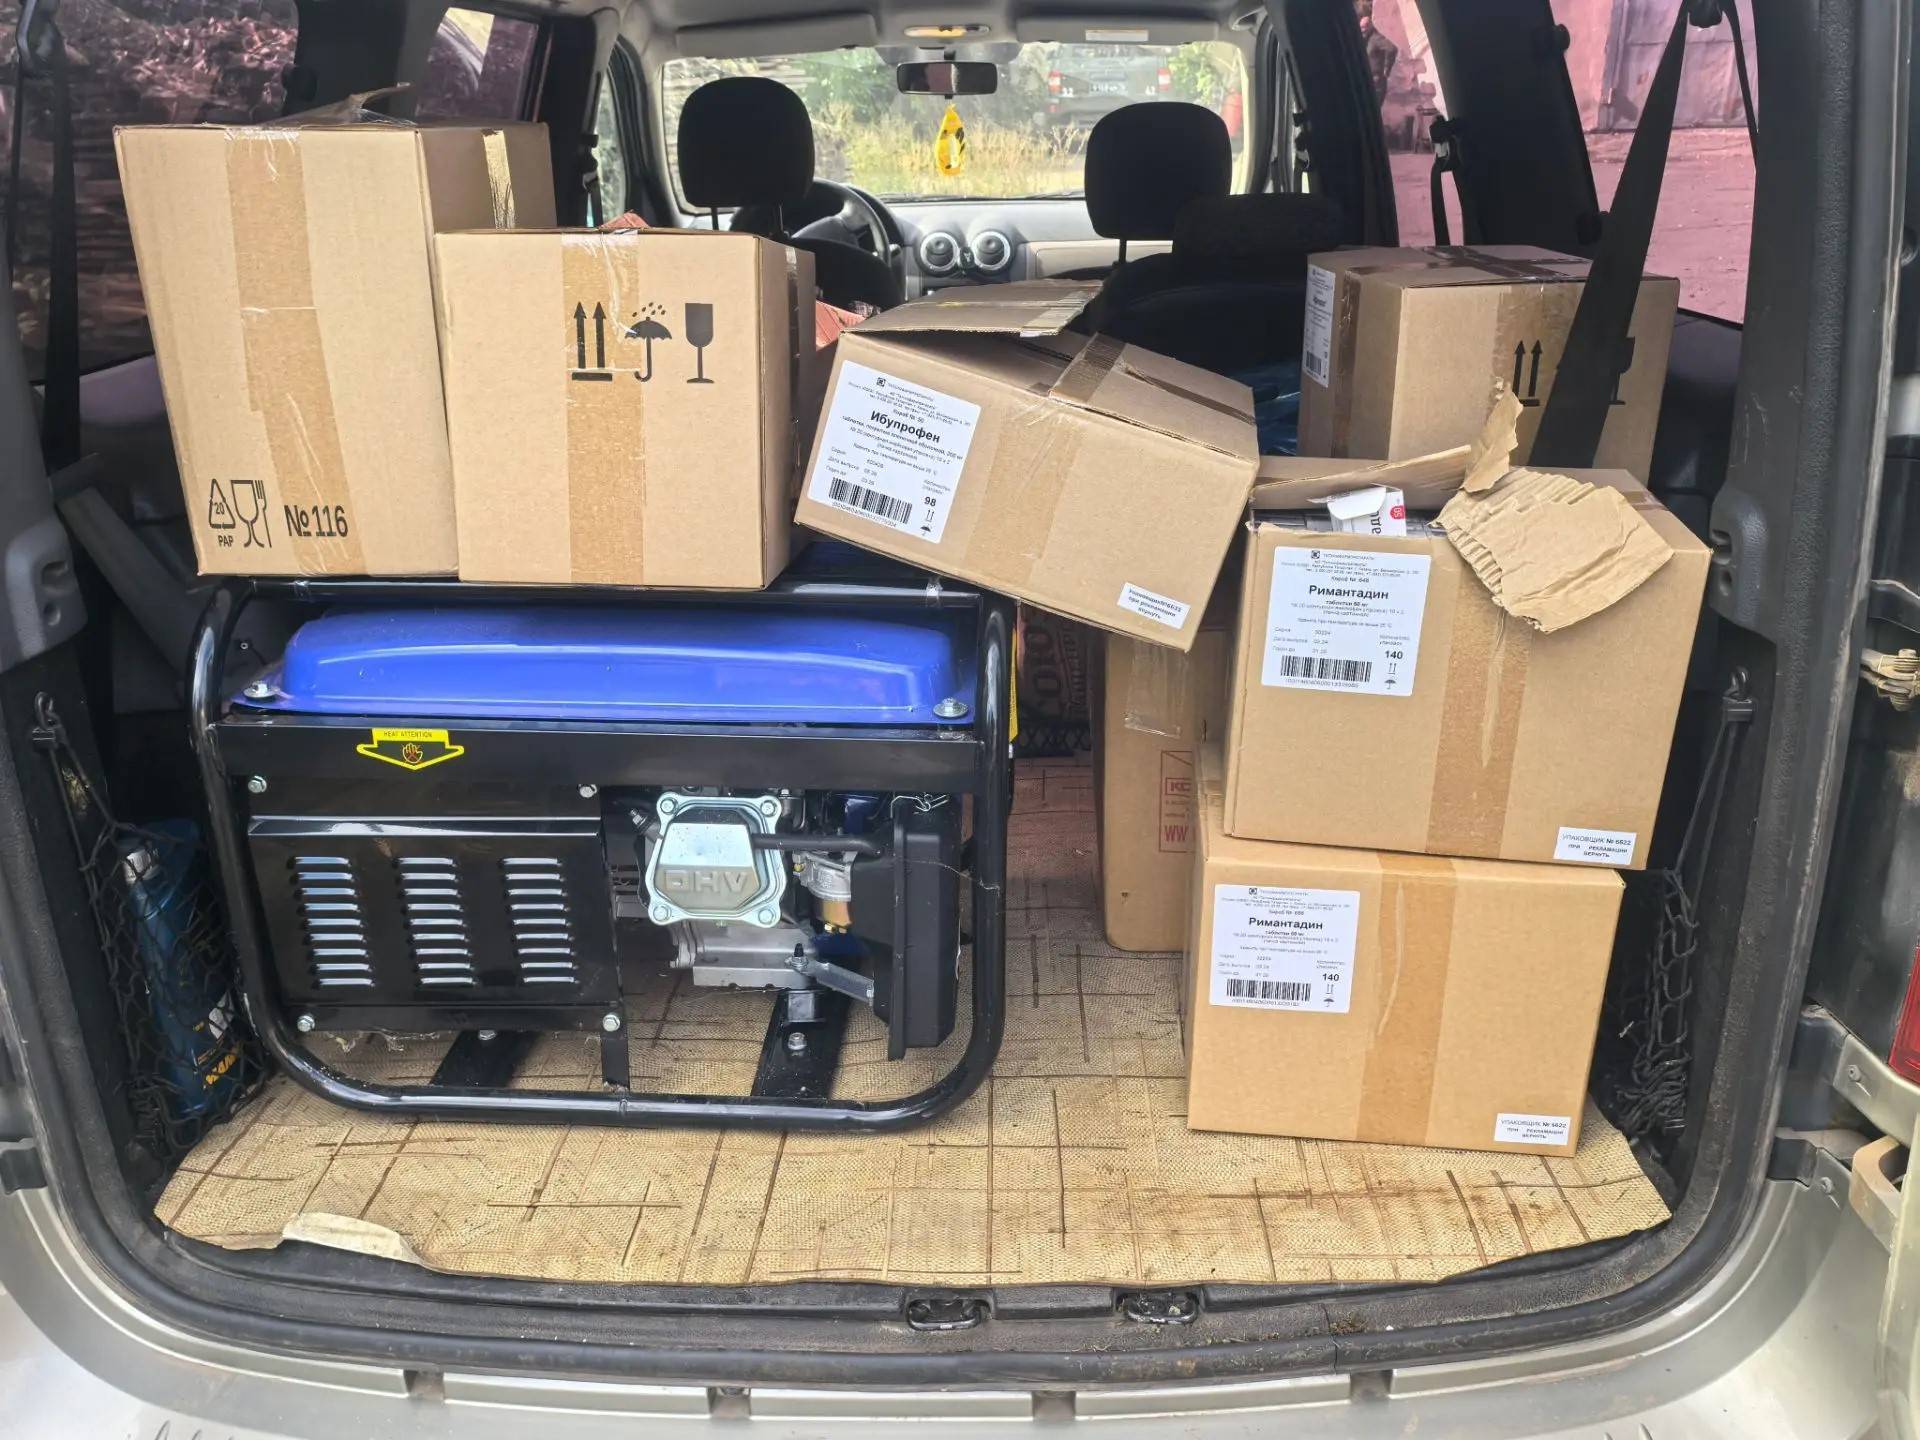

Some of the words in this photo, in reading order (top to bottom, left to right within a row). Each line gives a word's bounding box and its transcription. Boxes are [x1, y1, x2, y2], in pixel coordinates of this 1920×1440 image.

[869, 410, 941, 445] Ибупрофен
[923, 495, 937, 507] 98
[213, 502, 226, 515] 20
[218, 535, 234, 548] PAP
[1308, 584, 1389, 600] Римантадин
[1383, 650, 1403, 660] 140
[1248, 917, 1323, 930] Римантадин
[1321, 973, 1339, 981] 140
